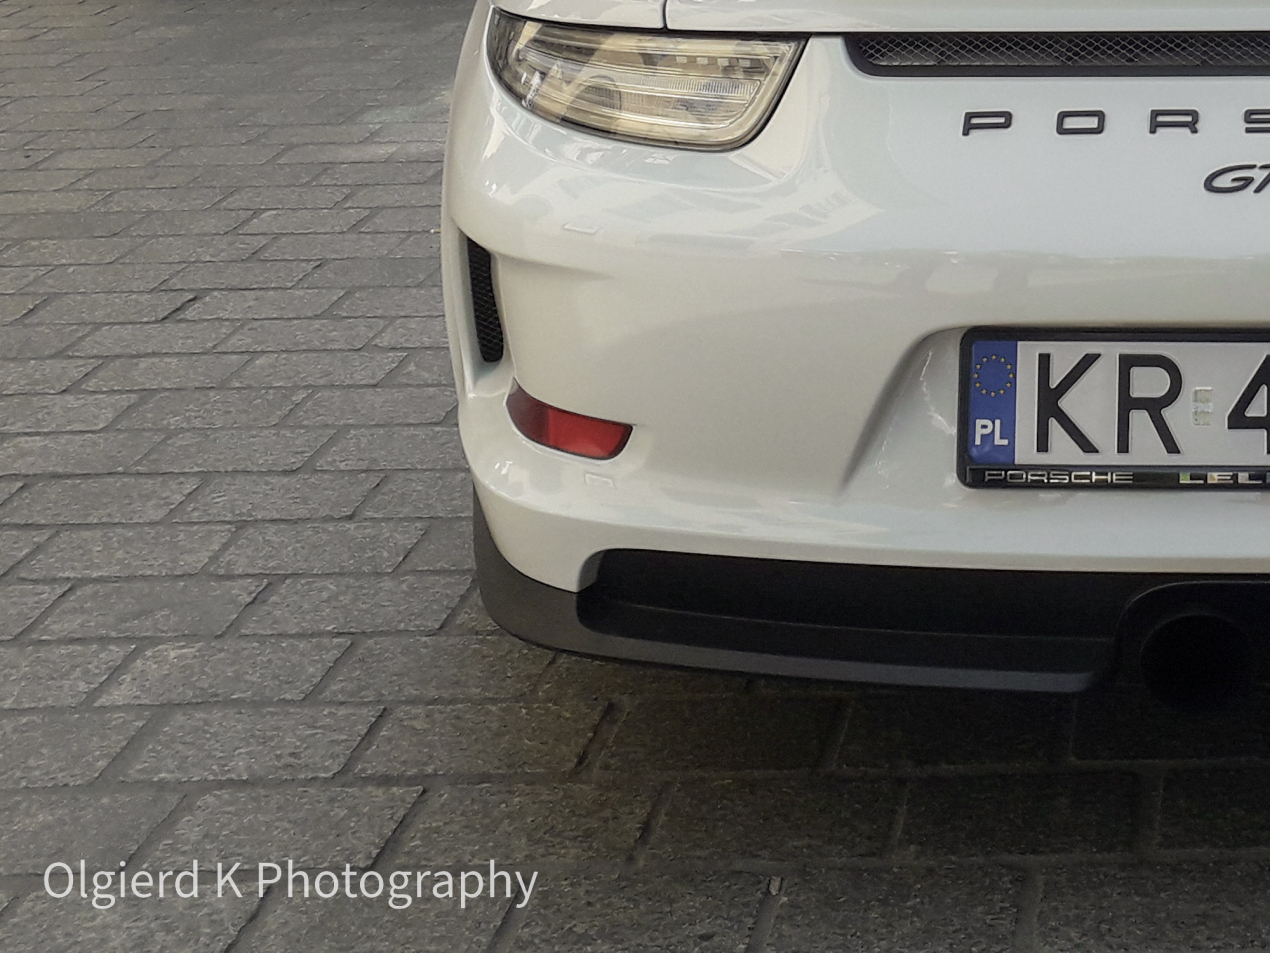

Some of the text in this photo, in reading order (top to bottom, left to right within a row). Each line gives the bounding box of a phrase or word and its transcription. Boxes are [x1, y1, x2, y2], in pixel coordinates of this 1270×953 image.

[1036, 353, 1183, 455] KR
[974, 419, 1009, 447] PL
[984, 471, 1134, 484] PORSCHE
